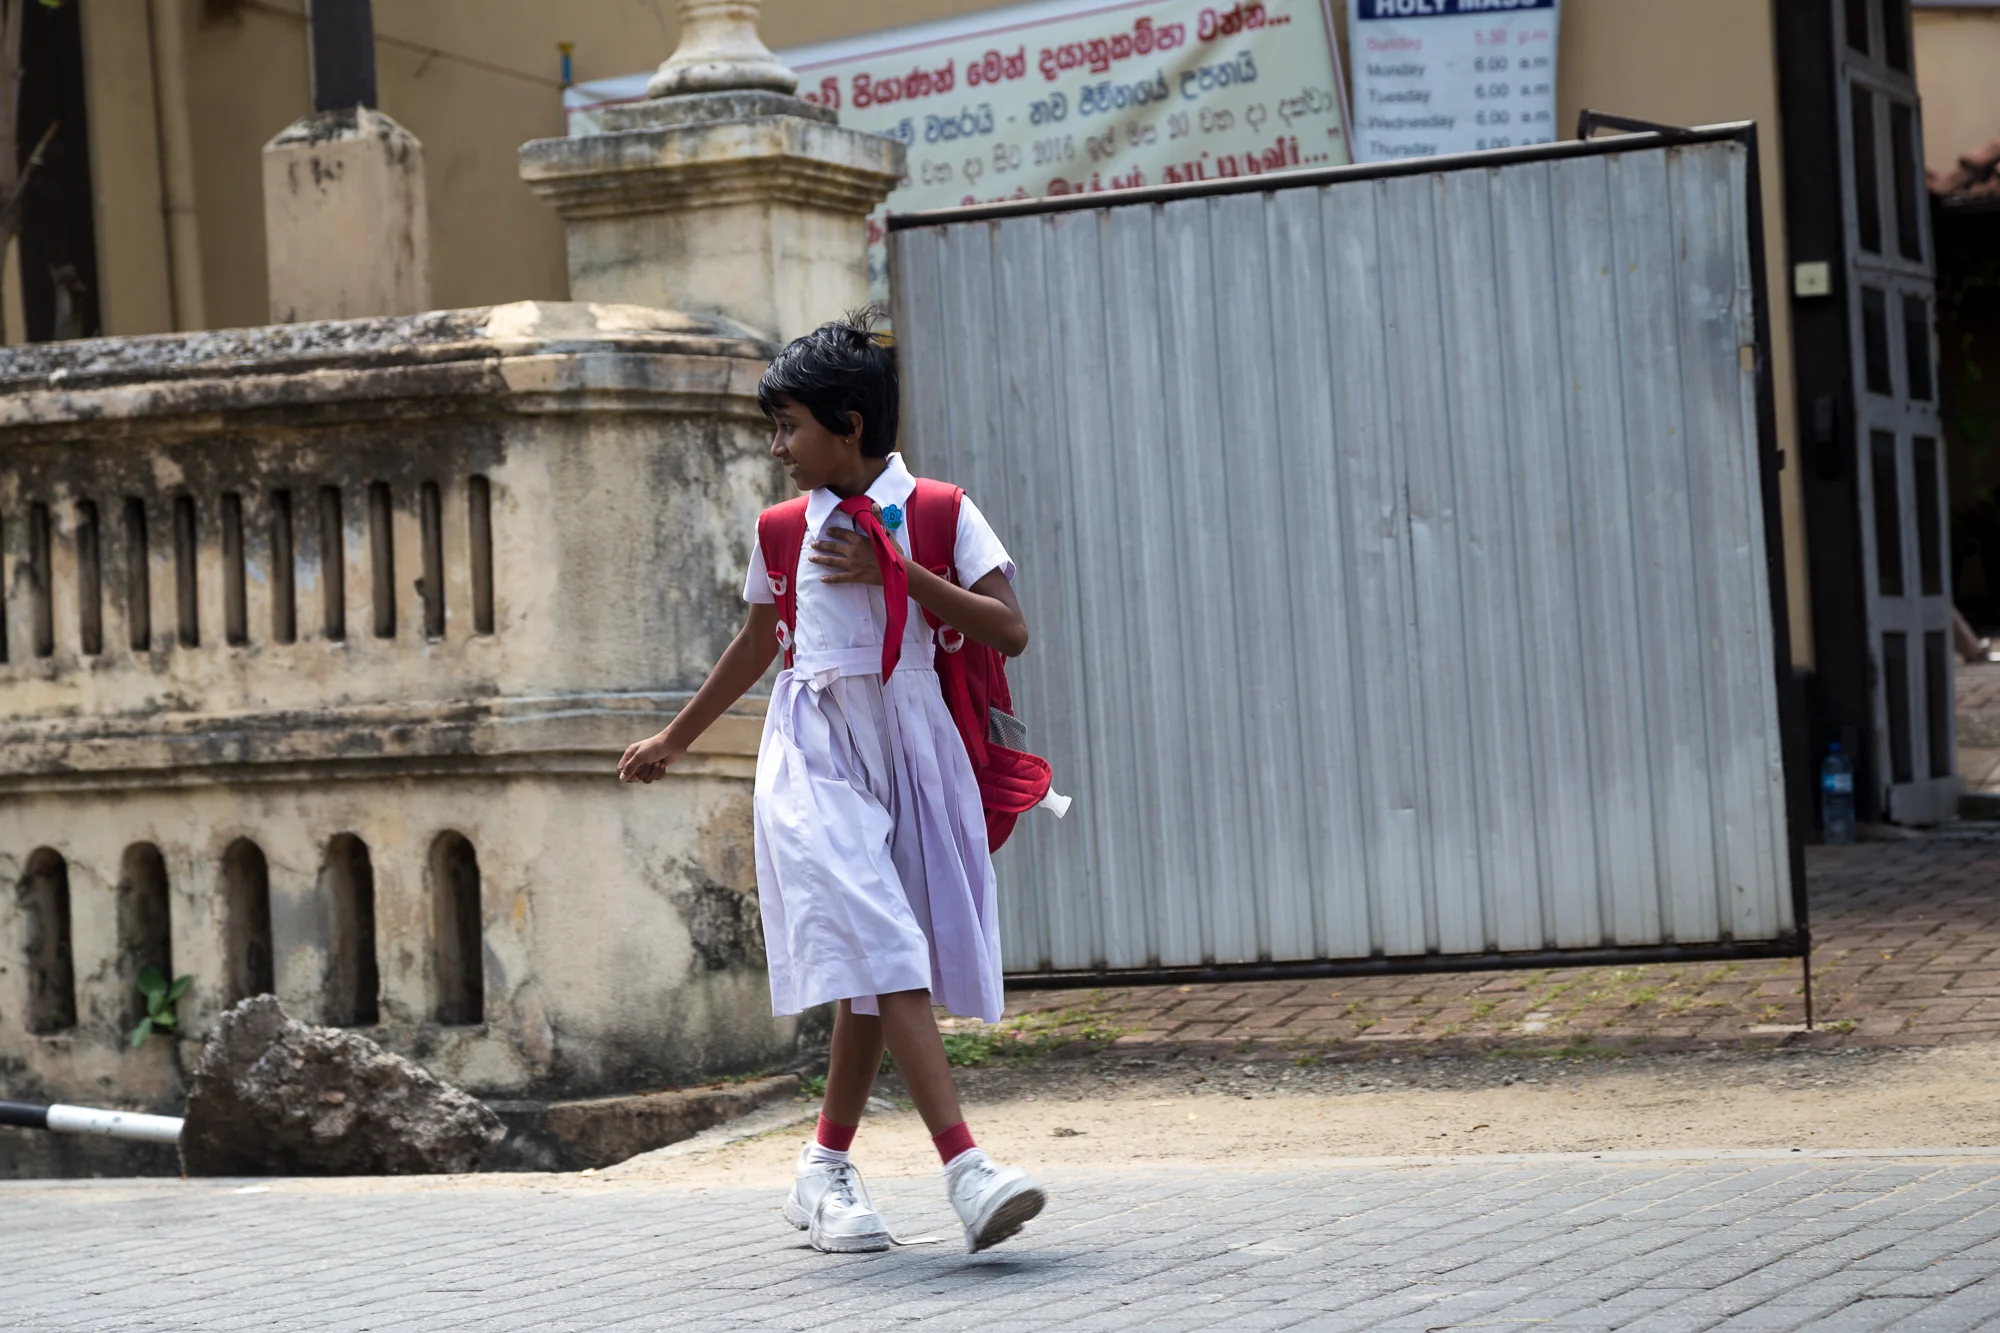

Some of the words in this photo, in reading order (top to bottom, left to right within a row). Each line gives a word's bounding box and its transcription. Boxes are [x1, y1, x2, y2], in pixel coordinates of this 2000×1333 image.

[1366, 37, 1423, 53] Sunday
[1366, 63, 1426, 79] Monday
[1474, 56, 1508, 73] 6.00
[1368, 88, 1432, 106] Tuesday
[1474, 82, 1509, 100] 6.00
[1368, 113, 1457, 132] Wednesday
[1475, 109, 1510, 127] 6.00
[1033, 133, 1076, 167] 2016
[1369, 140, 1439, 157] Thursday
[1476, 136, 1511, 150] 600
